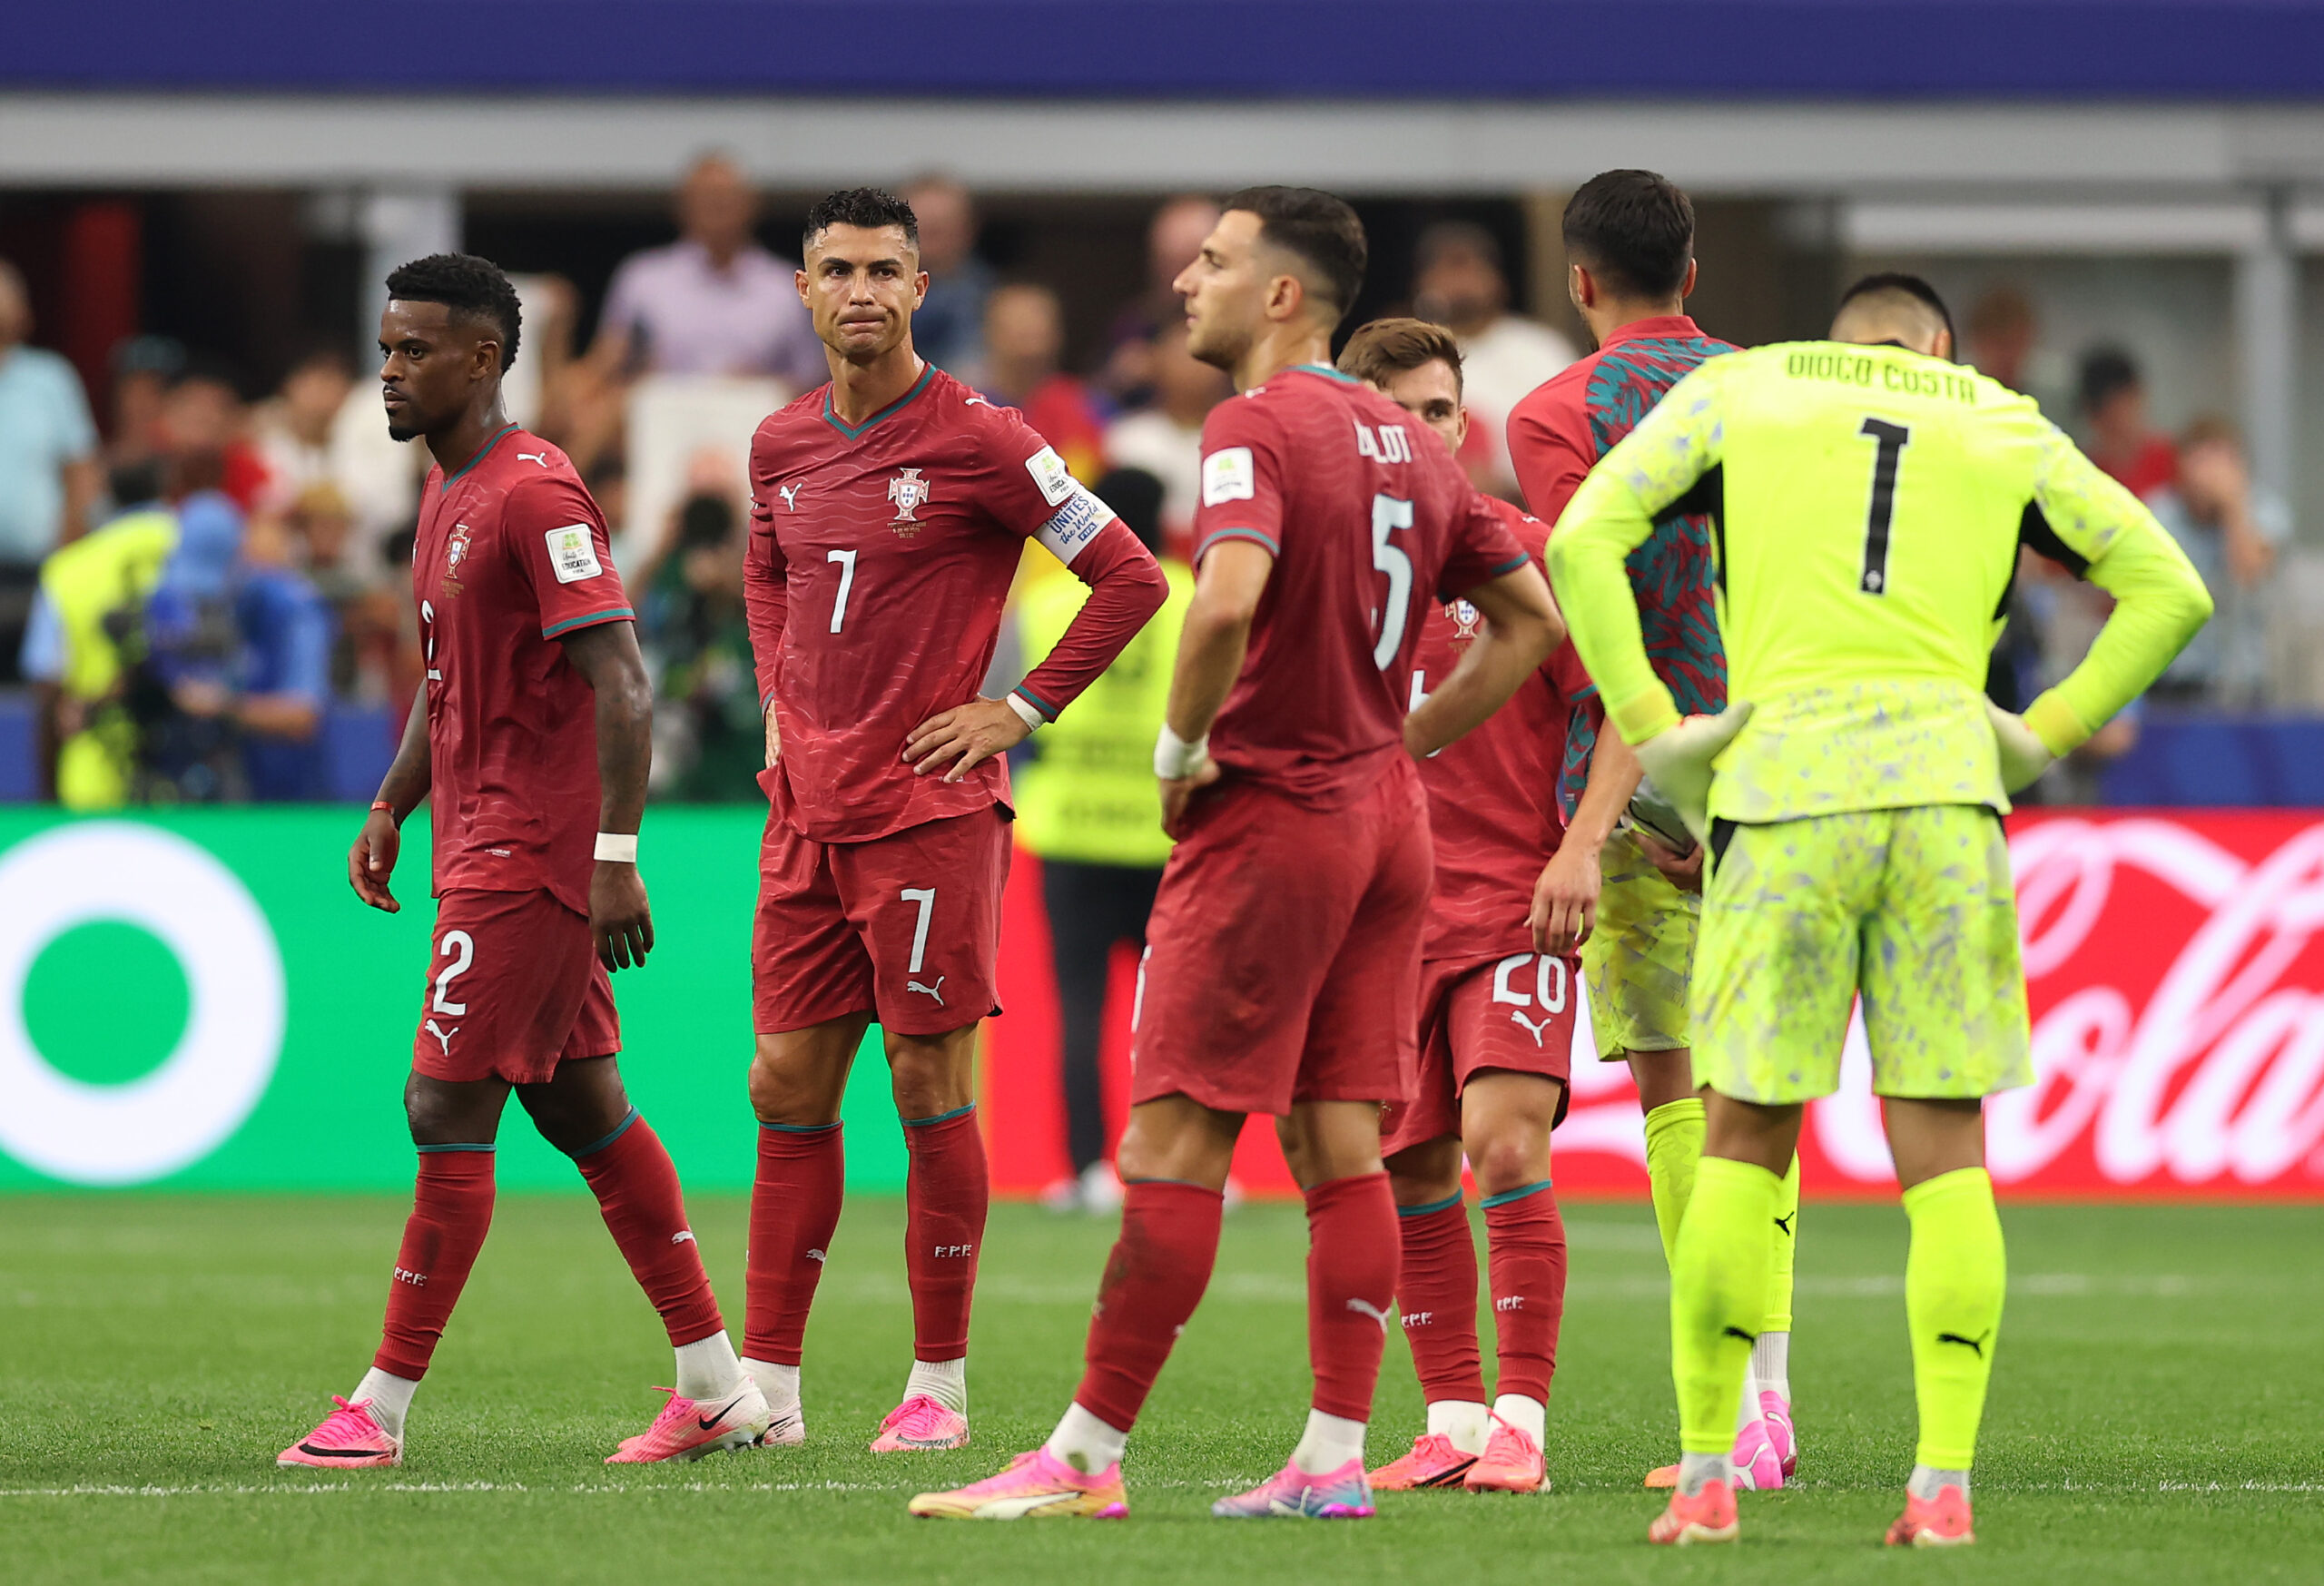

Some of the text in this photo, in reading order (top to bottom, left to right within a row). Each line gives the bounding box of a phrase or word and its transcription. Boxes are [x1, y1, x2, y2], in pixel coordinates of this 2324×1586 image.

[1049, 496, 1089, 534] UNITES
[1059, 503, 1100, 545] the World
[1078, 522, 1098, 541] FIFA
[1860, 418, 1909, 594] 1
[827, 549, 858, 634] 7
[1373, 493, 1414, 672] 5
[433, 929, 475, 1017] 2
[900, 887, 937, 974] 7
[1492, 953, 1567, 1015] 20
